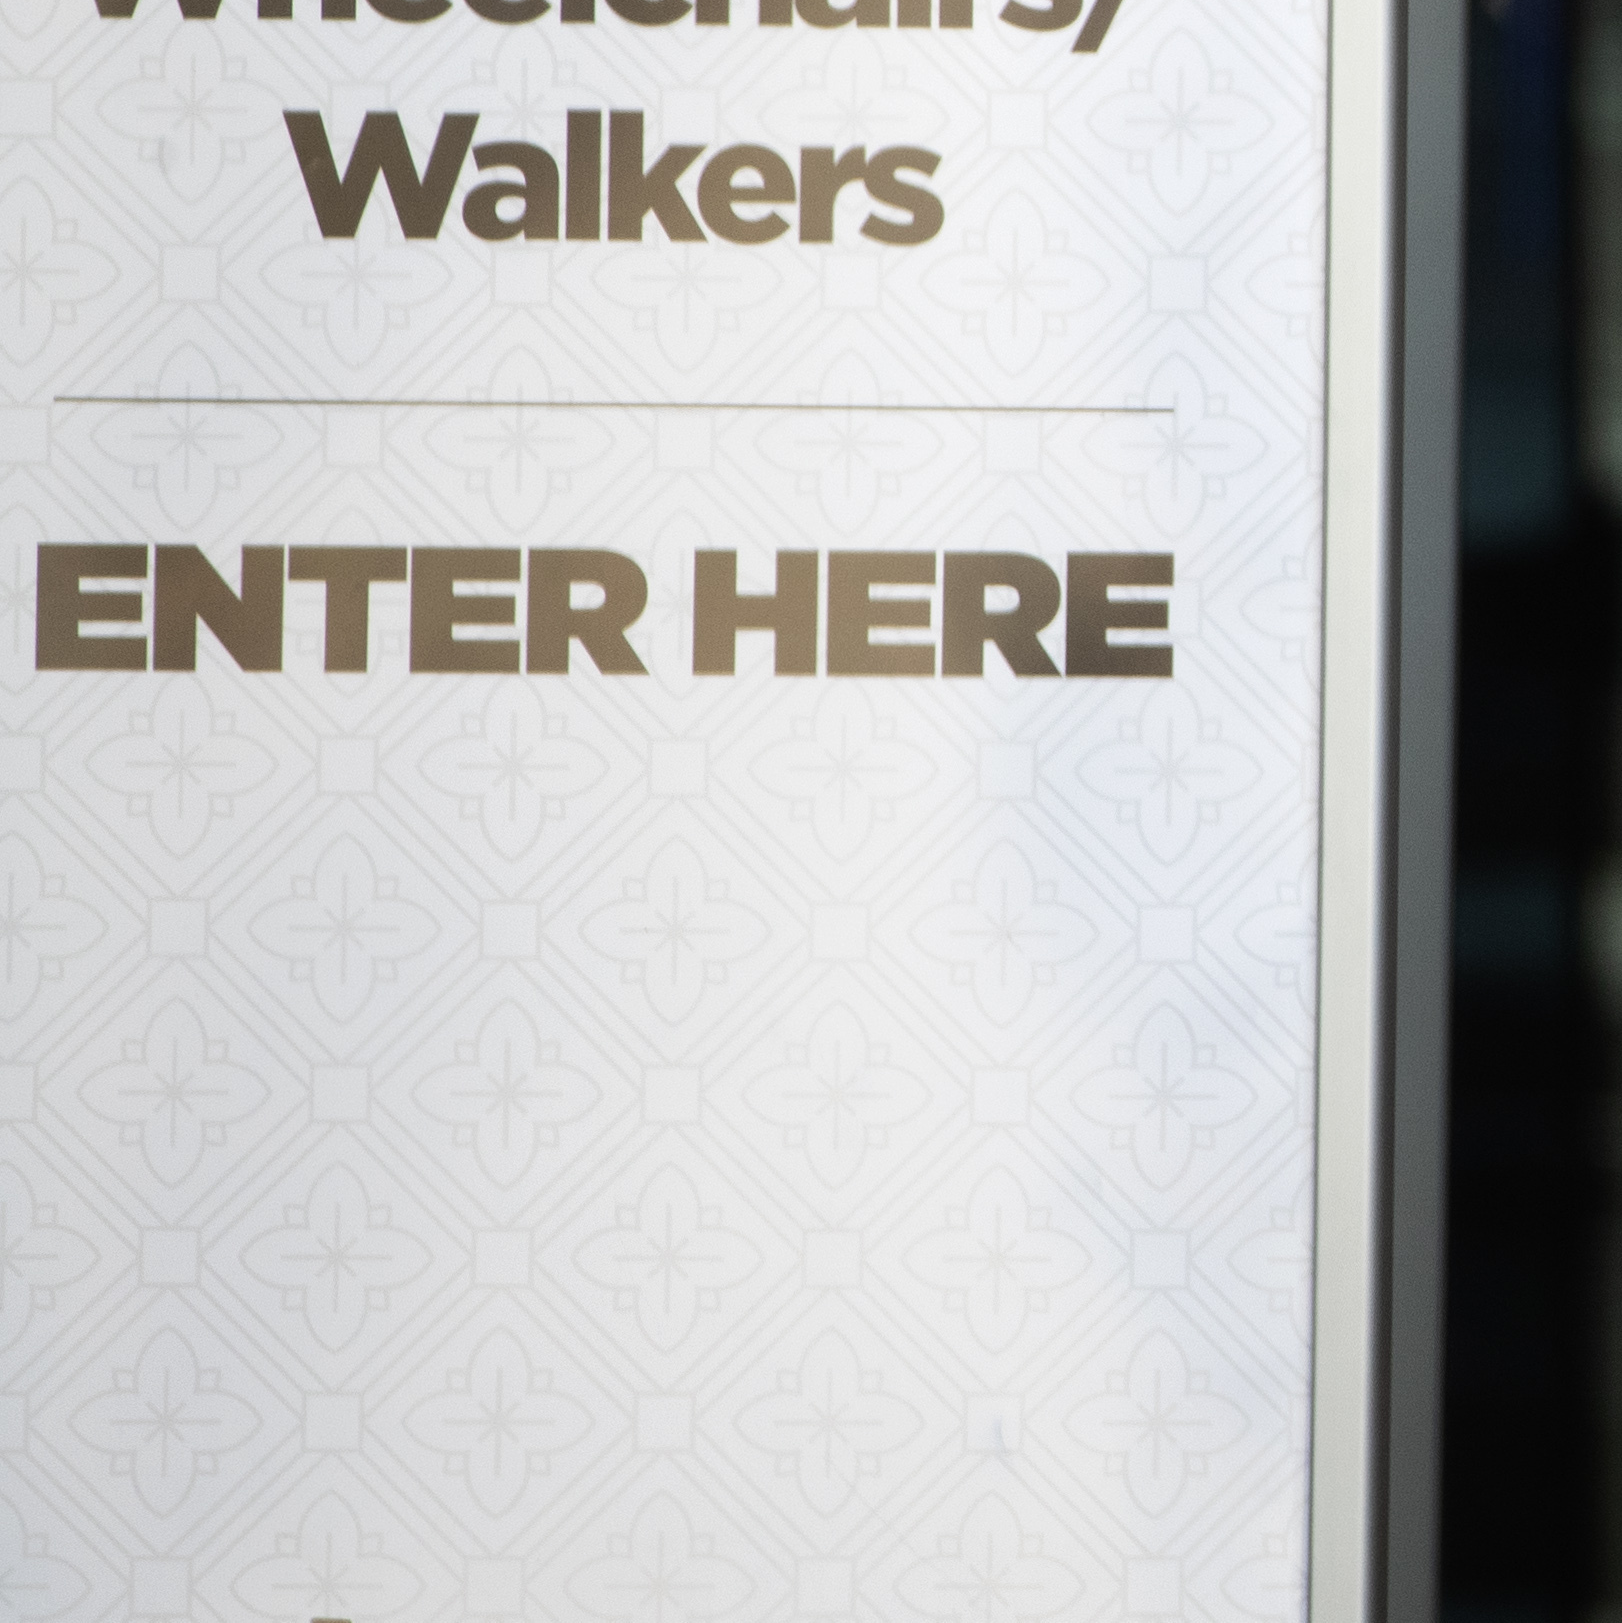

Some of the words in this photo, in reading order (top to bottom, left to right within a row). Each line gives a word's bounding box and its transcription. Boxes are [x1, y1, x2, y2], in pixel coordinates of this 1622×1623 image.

[283, 108, 944, 245] Walkers
[35, 542, 648, 675] ENTER
[693, 549, 1174, 679] HERE
